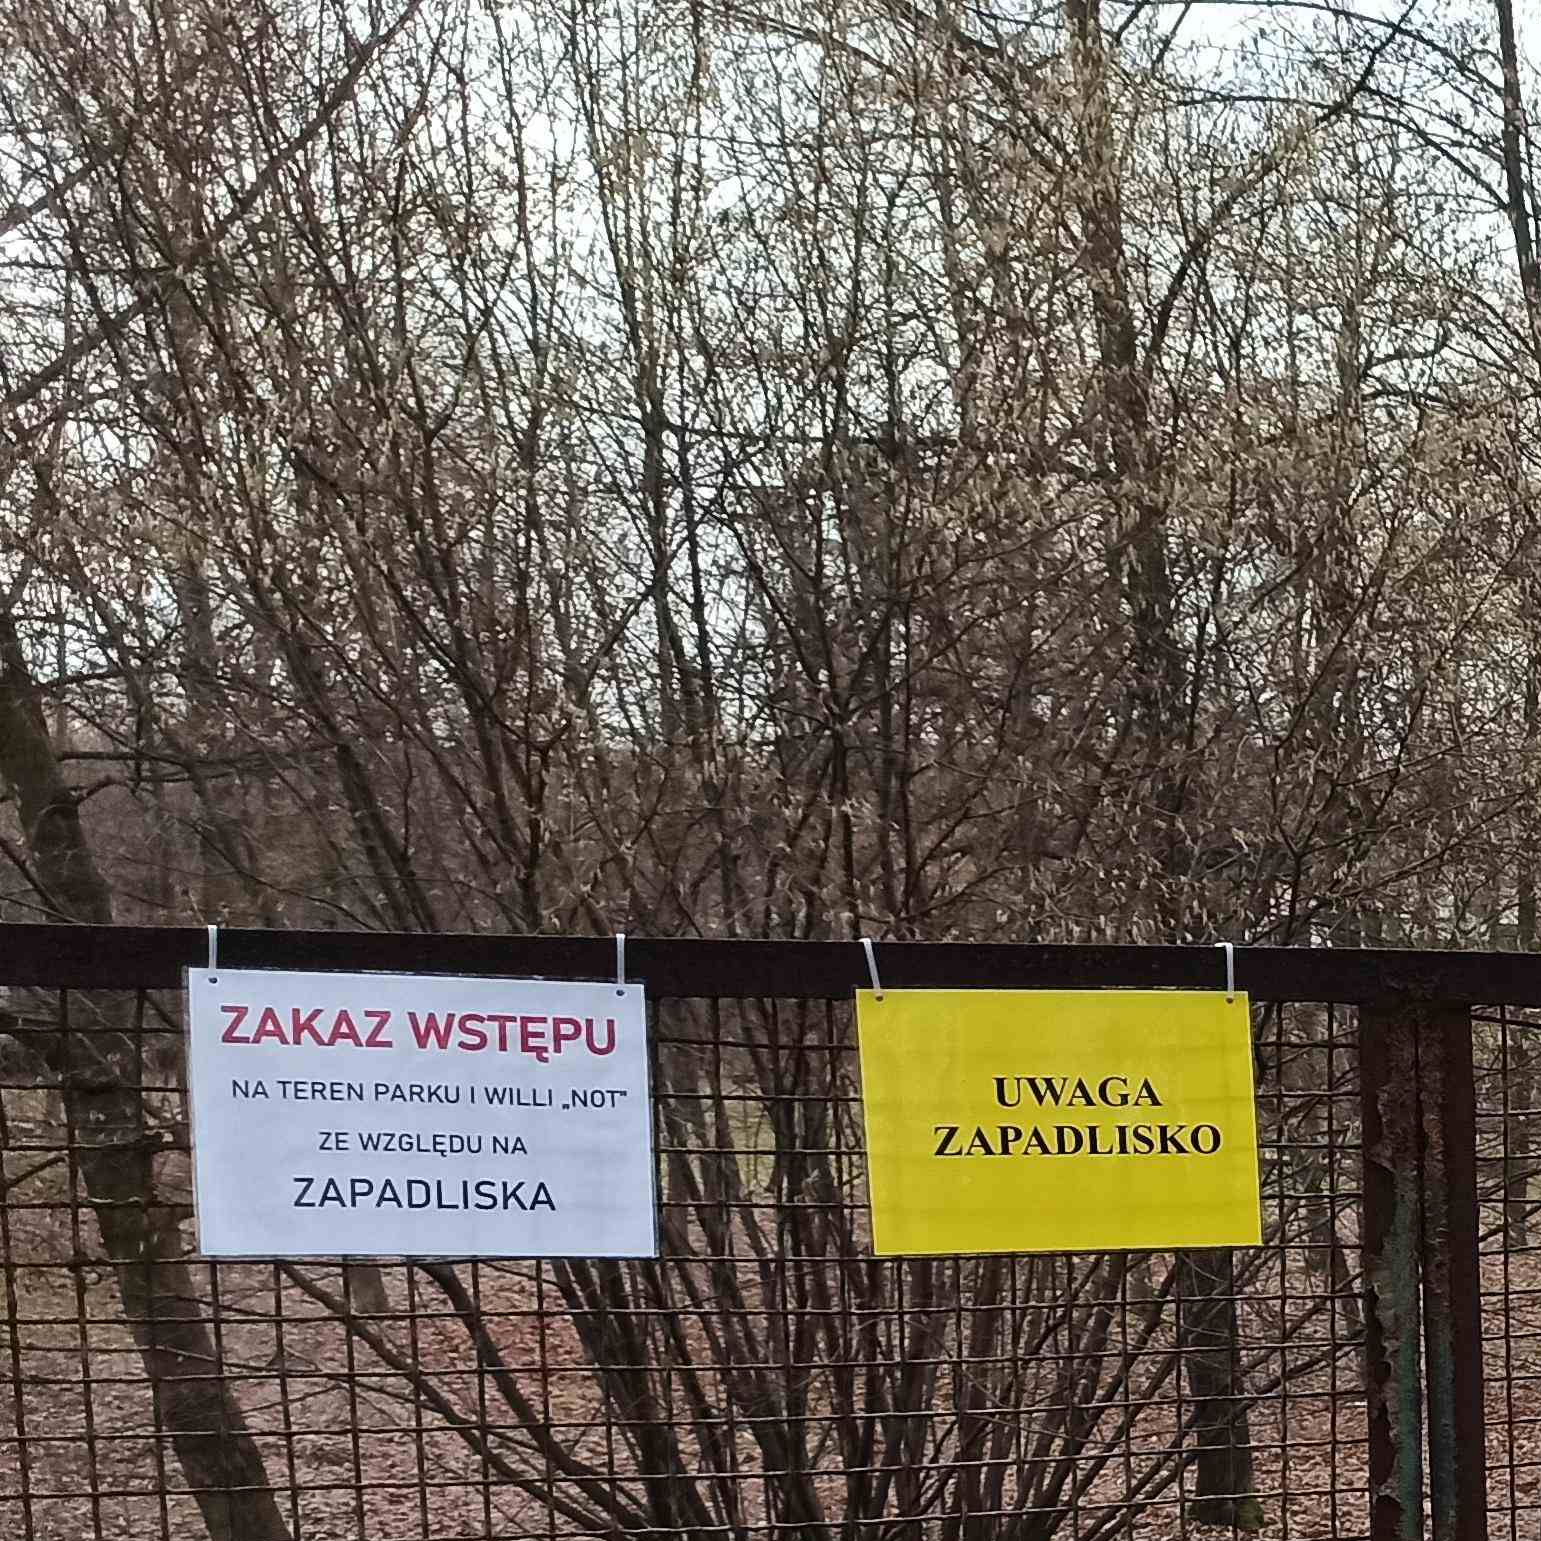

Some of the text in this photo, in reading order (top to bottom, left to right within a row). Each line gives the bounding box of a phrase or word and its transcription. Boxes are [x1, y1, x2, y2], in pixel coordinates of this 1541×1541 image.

[220, 1005, 616, 1064] ZAKAZ WSTĘPU
[231, 1079, 270, 1100] NA
[276, 1080, 364, 1102] TEREN
[374, 1082, 460, 1105] PARKU
[484, 1086, 553, 1108] WILLI
[991, 1076, 1164, 1108] UWAGA
[318, 1131, 528, 1158] ZE WZGLĘDU NA
[933, 1123, 1222, 1157] ZAPADLISKO
[293, 1177, 557, 1212] ZAPADLISKA
